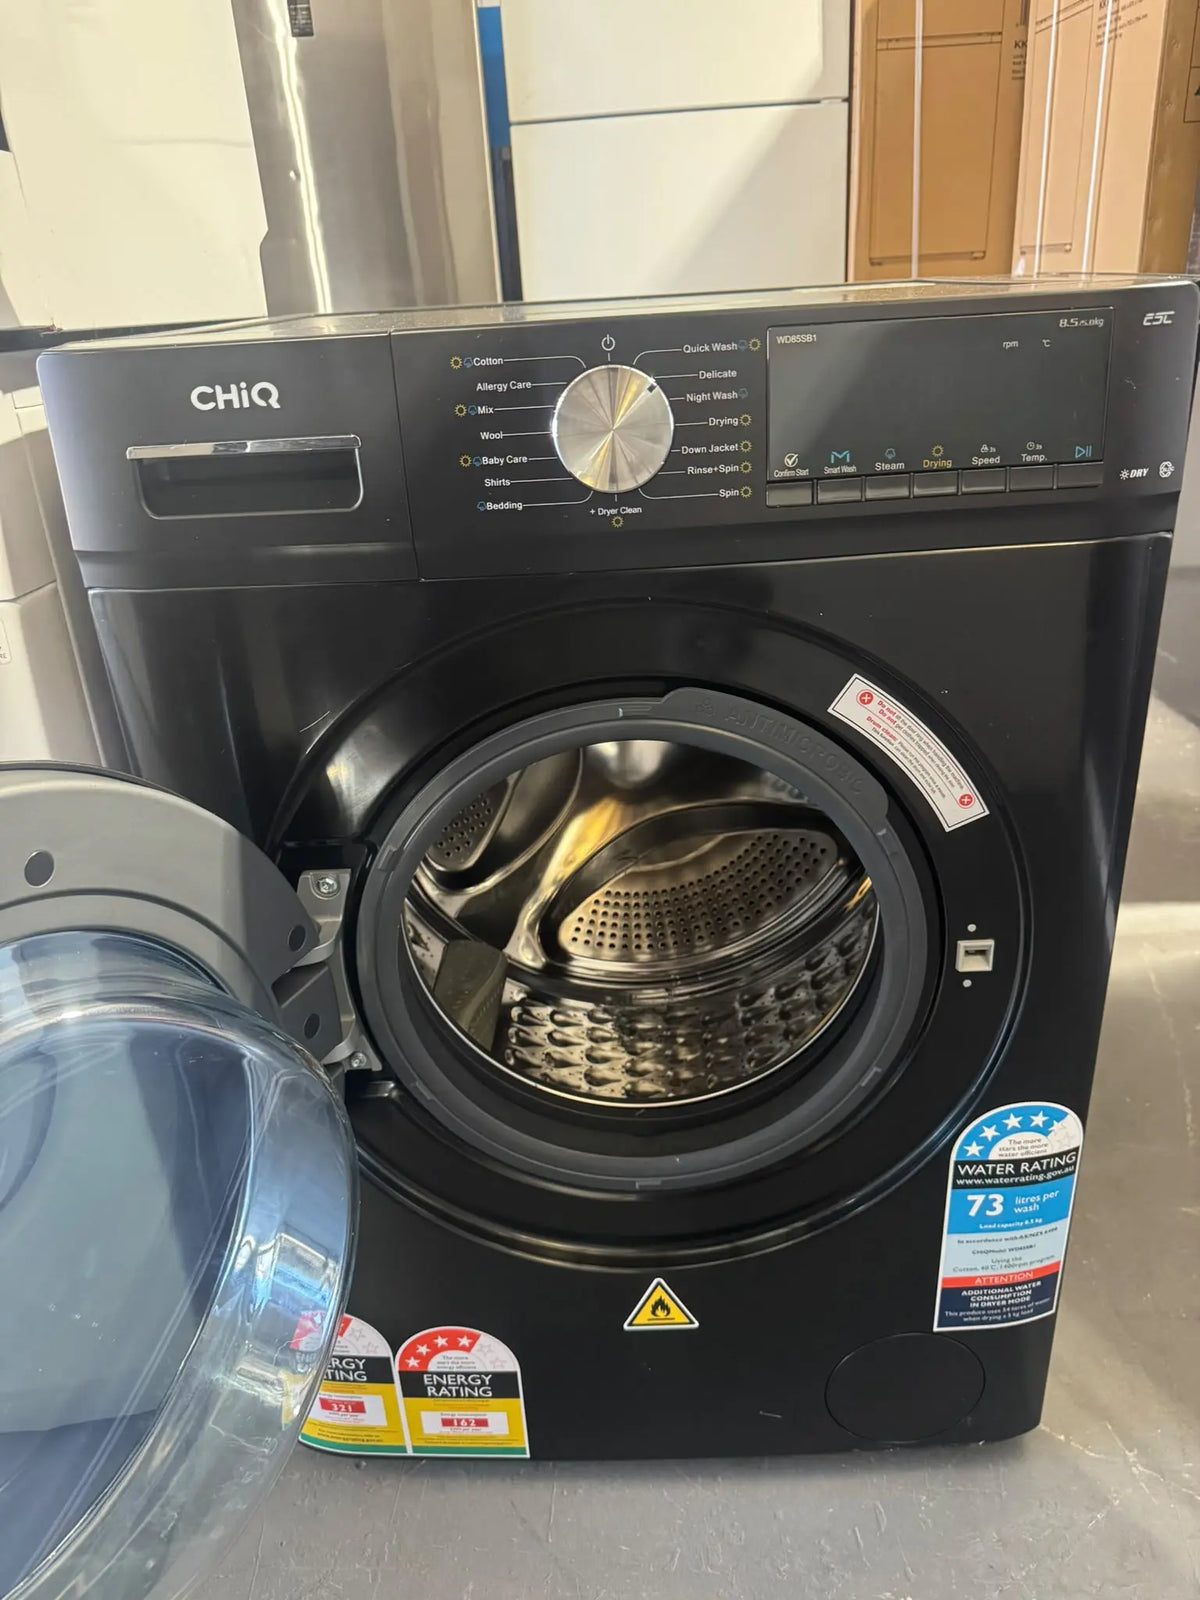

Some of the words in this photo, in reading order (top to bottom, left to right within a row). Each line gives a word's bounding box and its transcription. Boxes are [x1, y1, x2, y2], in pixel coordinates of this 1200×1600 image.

[776, 333, 817, 344] WD85SB1
[683, 344, 710, 353] Quick
[712, 341, 738, 352] Wash
[1003, 340, 1018, 350] rpm
[473, 357, 503, 366] Cotton
[699, 369, 737, 379] Delicate
[476, 382, 508, 392] Allergy
[509, 381, 532, 389] Care
[190, 381, 281, 411] CHiQ
[686, 392, 711, 403] Night
[712, 391, 738, 400] Wash
[477, 405, 494, 414] Mix
[709, 417, 739, 427] Drying
[480, 431, 503, 440] Wool
[681, 446, 707, 455] Down
[709, 443, 739, 453] Jacket
[482, 456, 504, 466] Baby
[506, 455, 528, 464] Care
[972, 456, 1000, 466] Speed
[1021, 453, 1047, 462] Temp.
[687, 464, 739, 475] Rinse+Spin
[875, 462, 905, 471] Steam
[922, 459, 952, 469] Drying
[774, 469, 795, 478] Confirm
[796, 468, 809, 477] Start
[824, 466, 840, 475] Smart
[841, 465, 857, 473] Wash
[1129, 468, 1149, 478] DRY
[484, 478, 511, 487] Shirts
[719, 488, 740, 498] Spin
[486, 501, 523, 511] Bedding
[598, 507, 618, 517] Dryer
[620, 506, 642, 514] Clean
[866, 716, 881, 728] Drum
[957, 1163, 1015, 1176] WATER
[1020, 1152, 1077, 1174] RATING
[956, 1165, 1075, 1185] www.waterrating.gov.au
[1015, 1194, 1040, 1204] litres
[1042, 1190, 1060, 1202] per
[967, 1193, 1004, 1218] 73
[1014, 1203, 1040, 1214] wash
[975, 1271, 1034, 1285] ATTENTION
[961, 1287, 1014, 1296] ADDITIONAL
[1015, 1281, 1042, 1291] WATER
[970, 1290, 1032, 1302] CONSUMPTION
[980, 1299, 1007, 1308] DRYER
[1008, 1296, 1031, 1304] MODE
[328, 1358, 366, 1370] RGY
[324, 1369, 367, 1381] TING
[423, 1374, 492, 1385] ENERGY
[427, 1386, 493, 1397] RATING
[453, 1419, 476, 1427] 162
